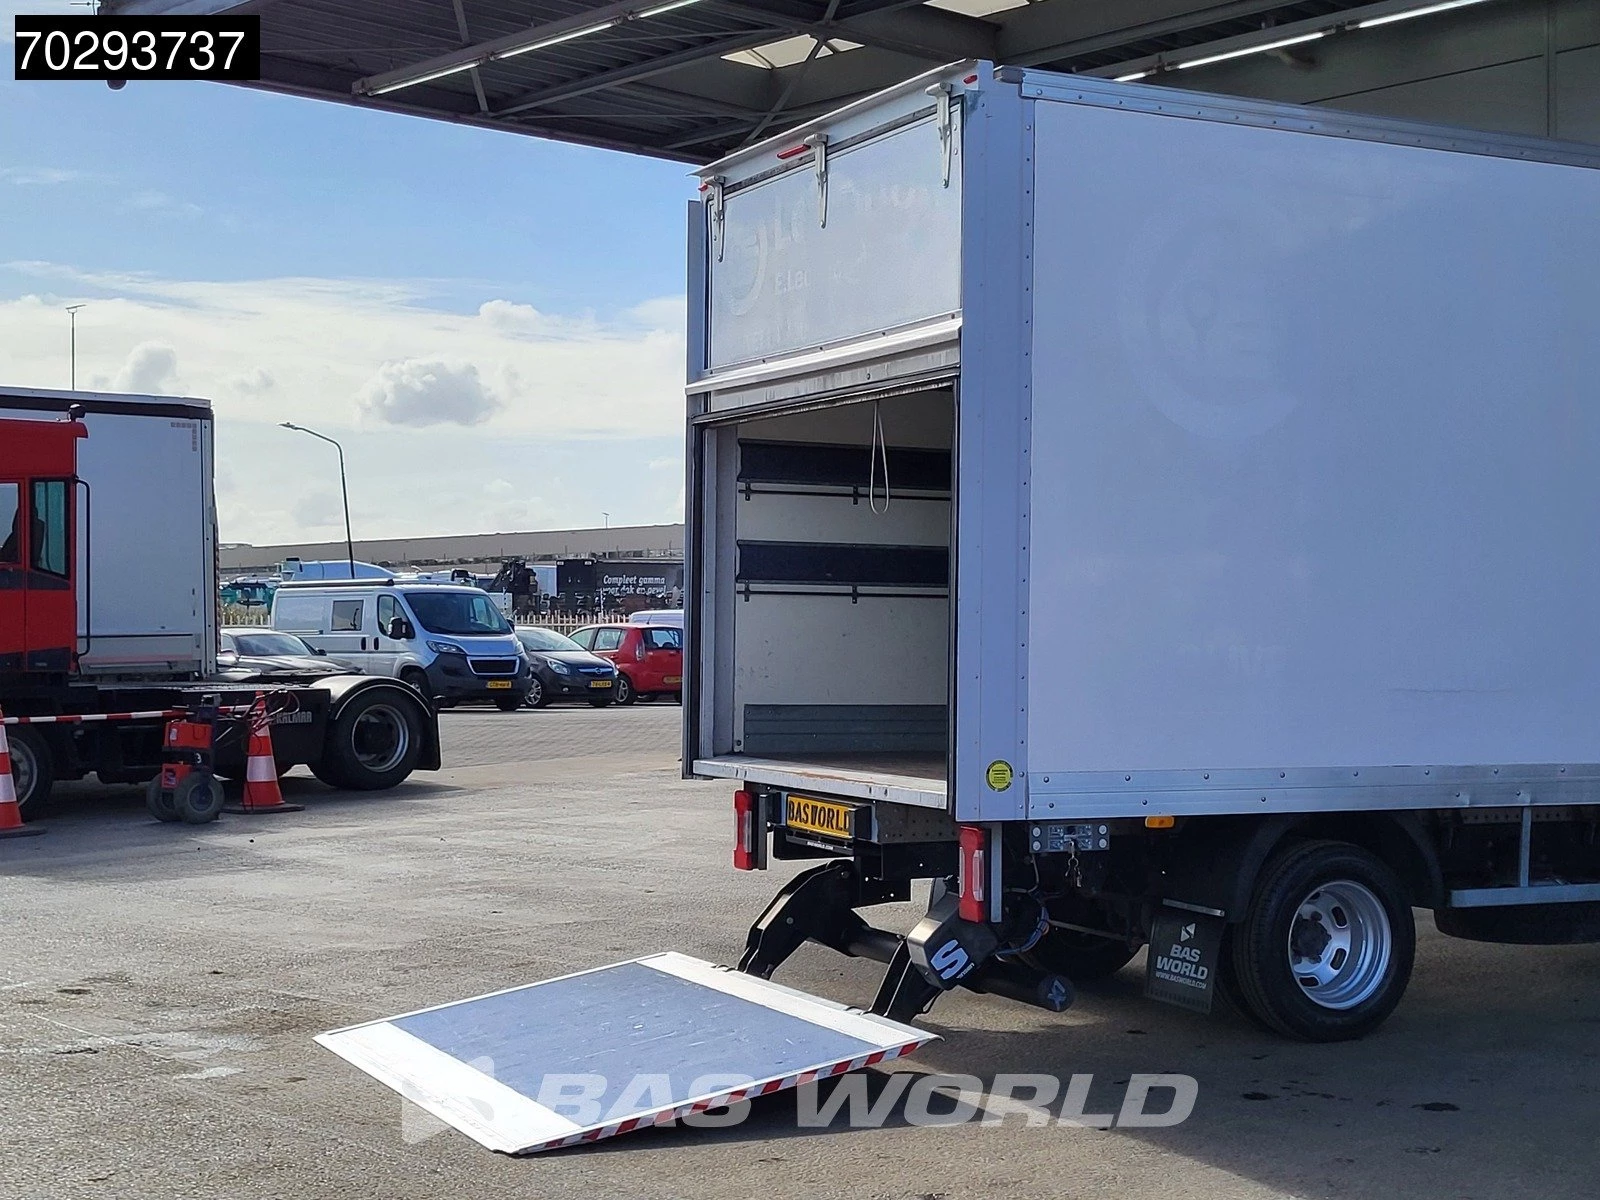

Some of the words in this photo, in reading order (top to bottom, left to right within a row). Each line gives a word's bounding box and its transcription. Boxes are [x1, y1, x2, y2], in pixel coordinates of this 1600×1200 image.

[603, 574, 637, 586] Compleet
[638, 576, 666, 586] gamma
[276, 711, 313, 724] KALMAR
[1170, 944, 1201, 962] BAS
[1156, 956, 1208, 980] WORLD
